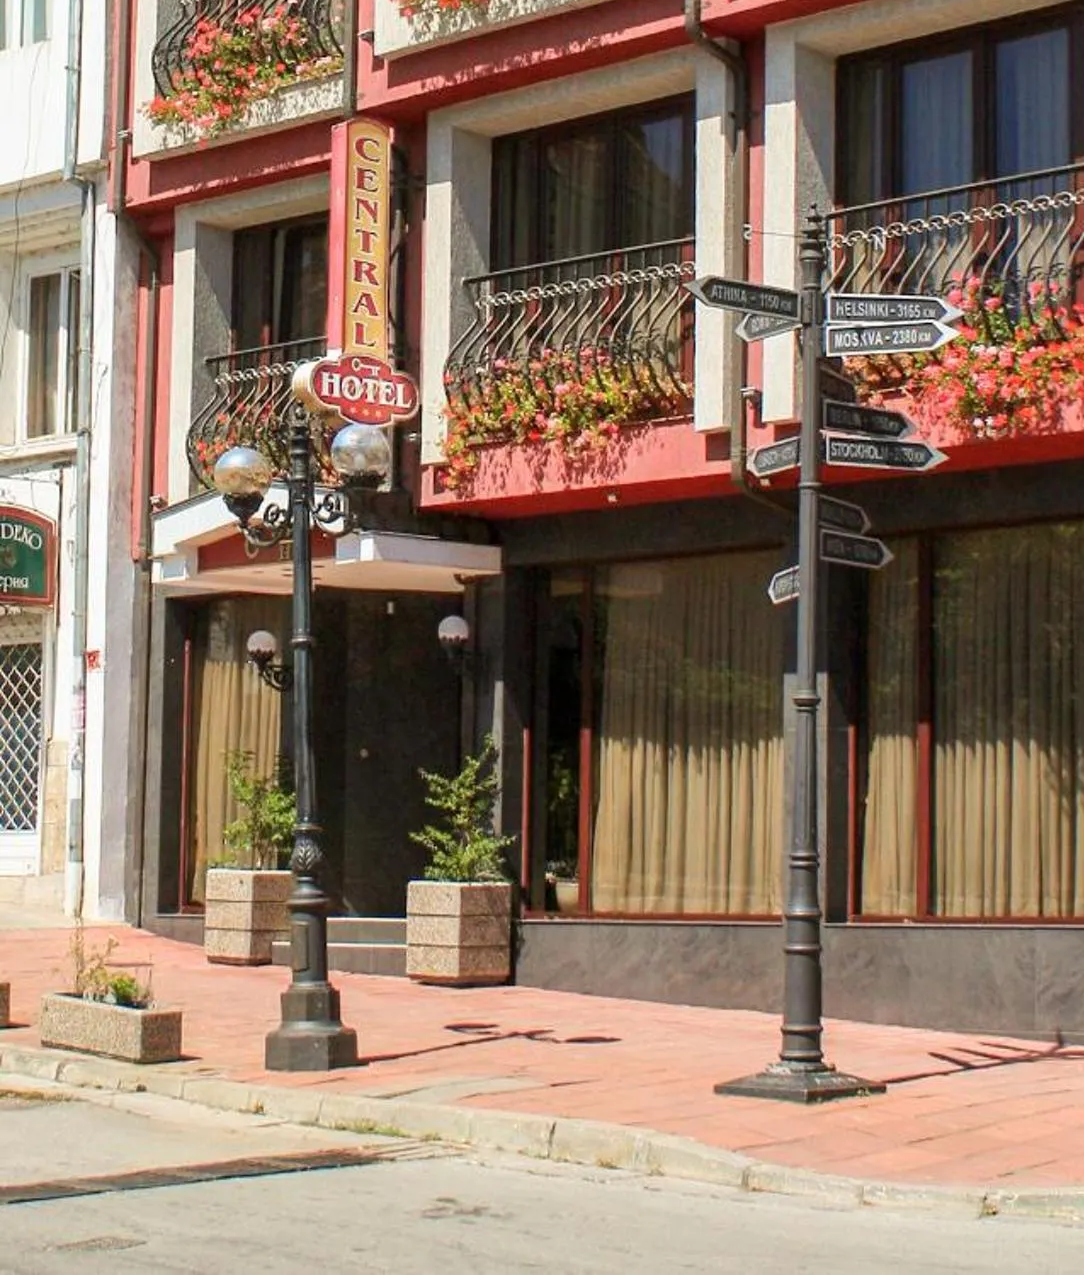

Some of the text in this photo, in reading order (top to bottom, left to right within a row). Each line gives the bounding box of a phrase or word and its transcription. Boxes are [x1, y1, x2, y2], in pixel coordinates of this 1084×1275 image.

[353, 137, 381, 348] CENTRAL
[836, 302, 889, 317] HELSINKI
[834, 331, 884, 349] MOSKVA
[320, 371, 413, 409] HOTEL
